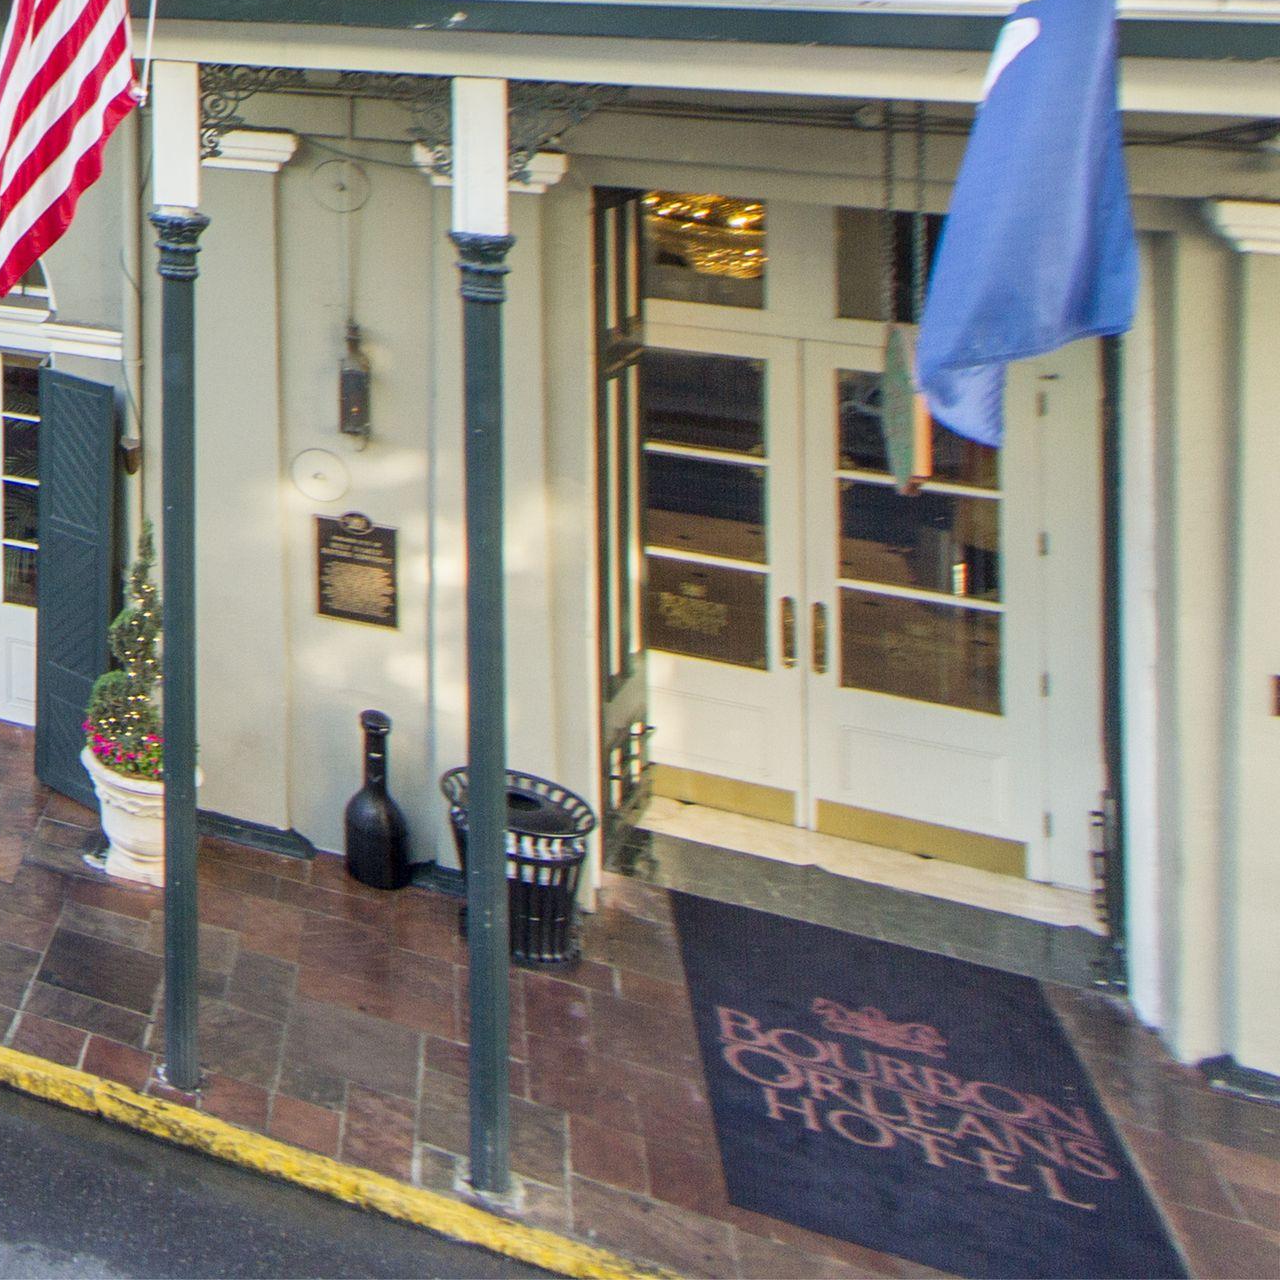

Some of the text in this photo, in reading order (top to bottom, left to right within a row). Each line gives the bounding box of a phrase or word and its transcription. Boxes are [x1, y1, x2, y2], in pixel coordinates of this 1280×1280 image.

[715, 1004, 1099, 1138] BOURBON
[722, 1043, 1121, 1182] ORLEANS
[763, 1086, 1097, 1211] HOTEL
